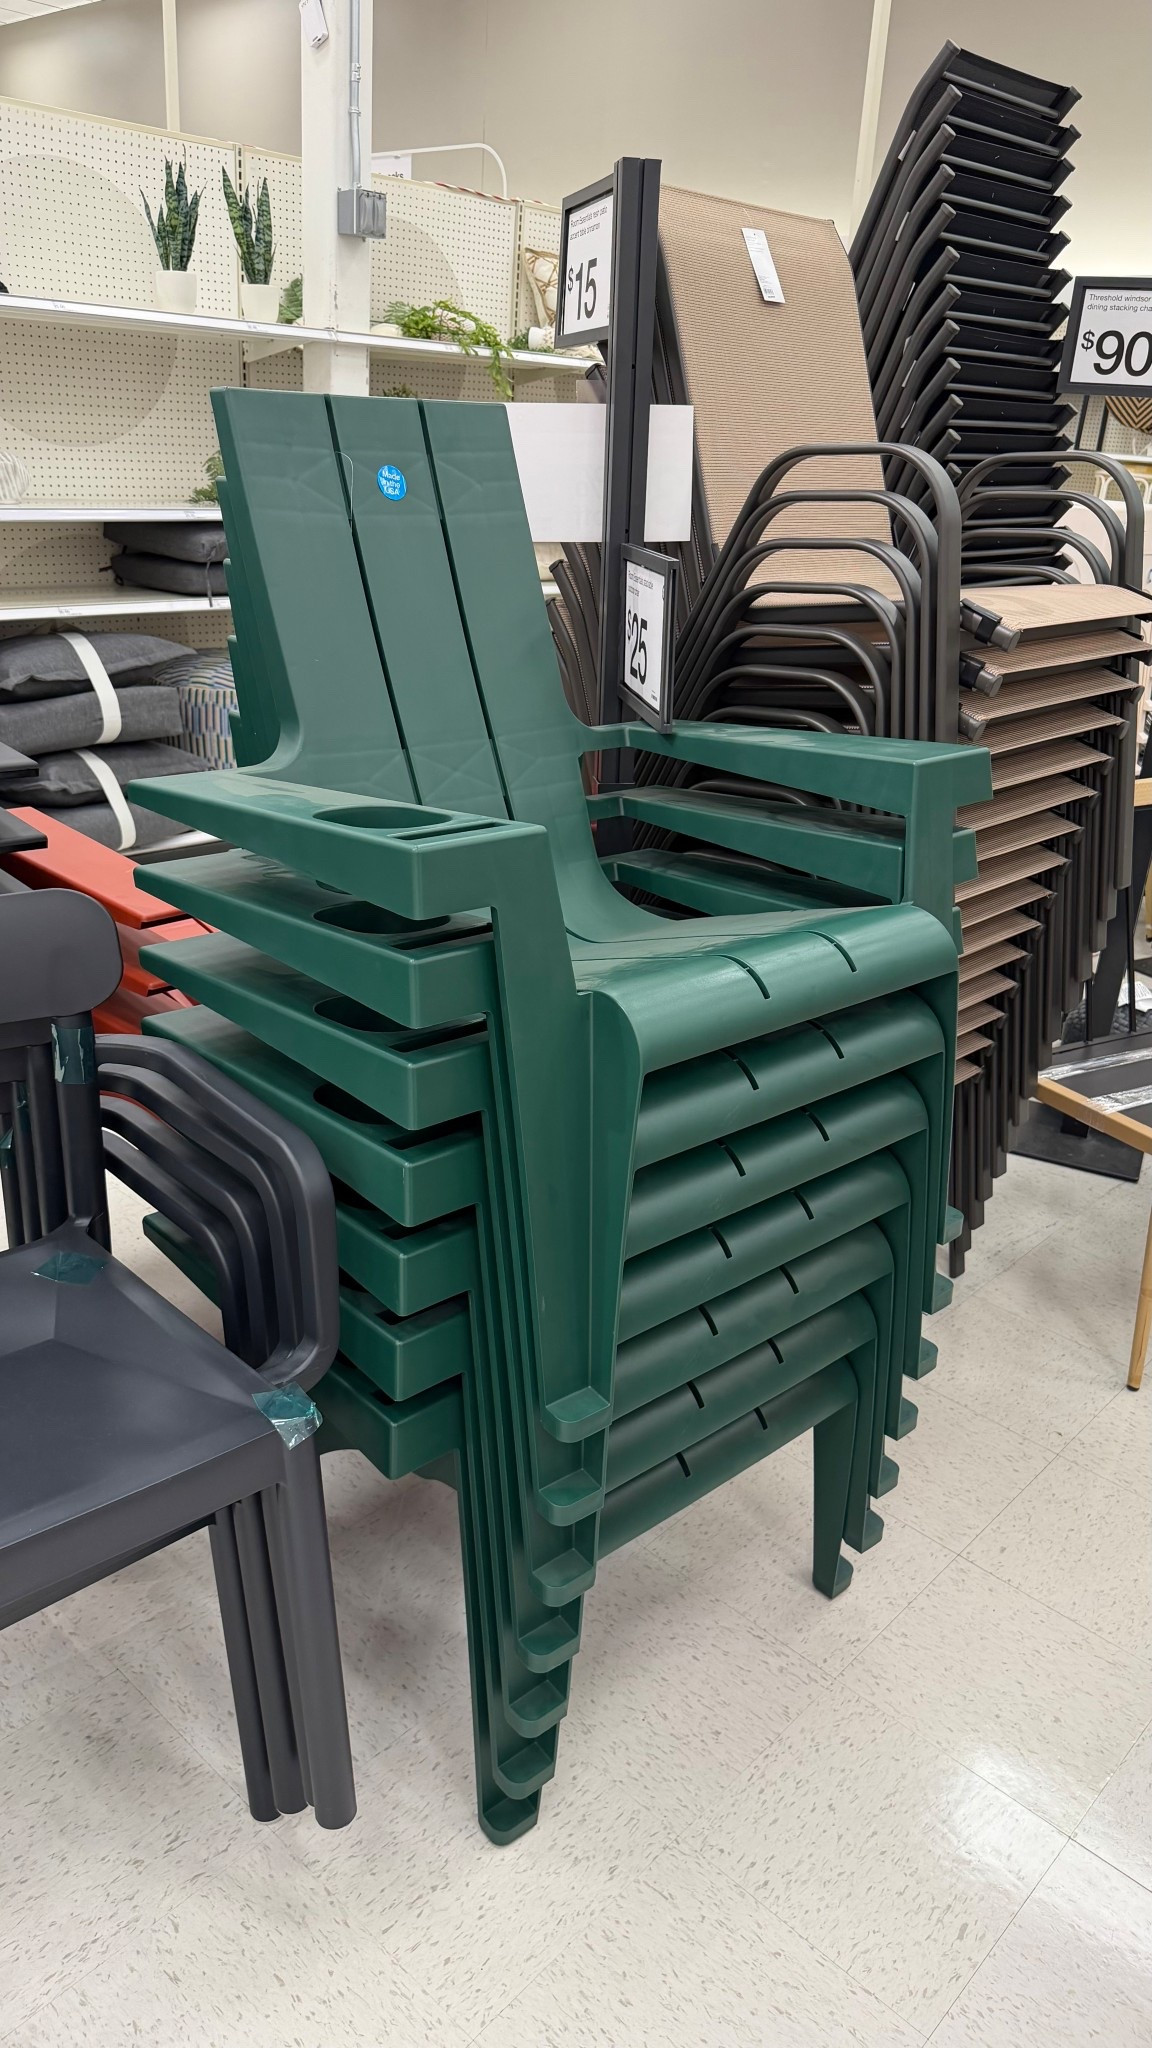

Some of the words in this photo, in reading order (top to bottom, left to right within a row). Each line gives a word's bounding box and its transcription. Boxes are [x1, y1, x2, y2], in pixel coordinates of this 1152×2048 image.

[568, 258, 597, 320] $15
[1089, 293, 1123, 302] Threshold
[1124, 294, 1152, 303] windsor
[1087, 303, 1108, 312] dining
[1109, 304, 1138, 313] stacking
[1081, 329, 1152, 377] $90
[382, 469, 401, 481] Made
[389, 480, 401, 489] the
[384, 486, 400, 496] USA
[627, 607, 648, 685] $25
